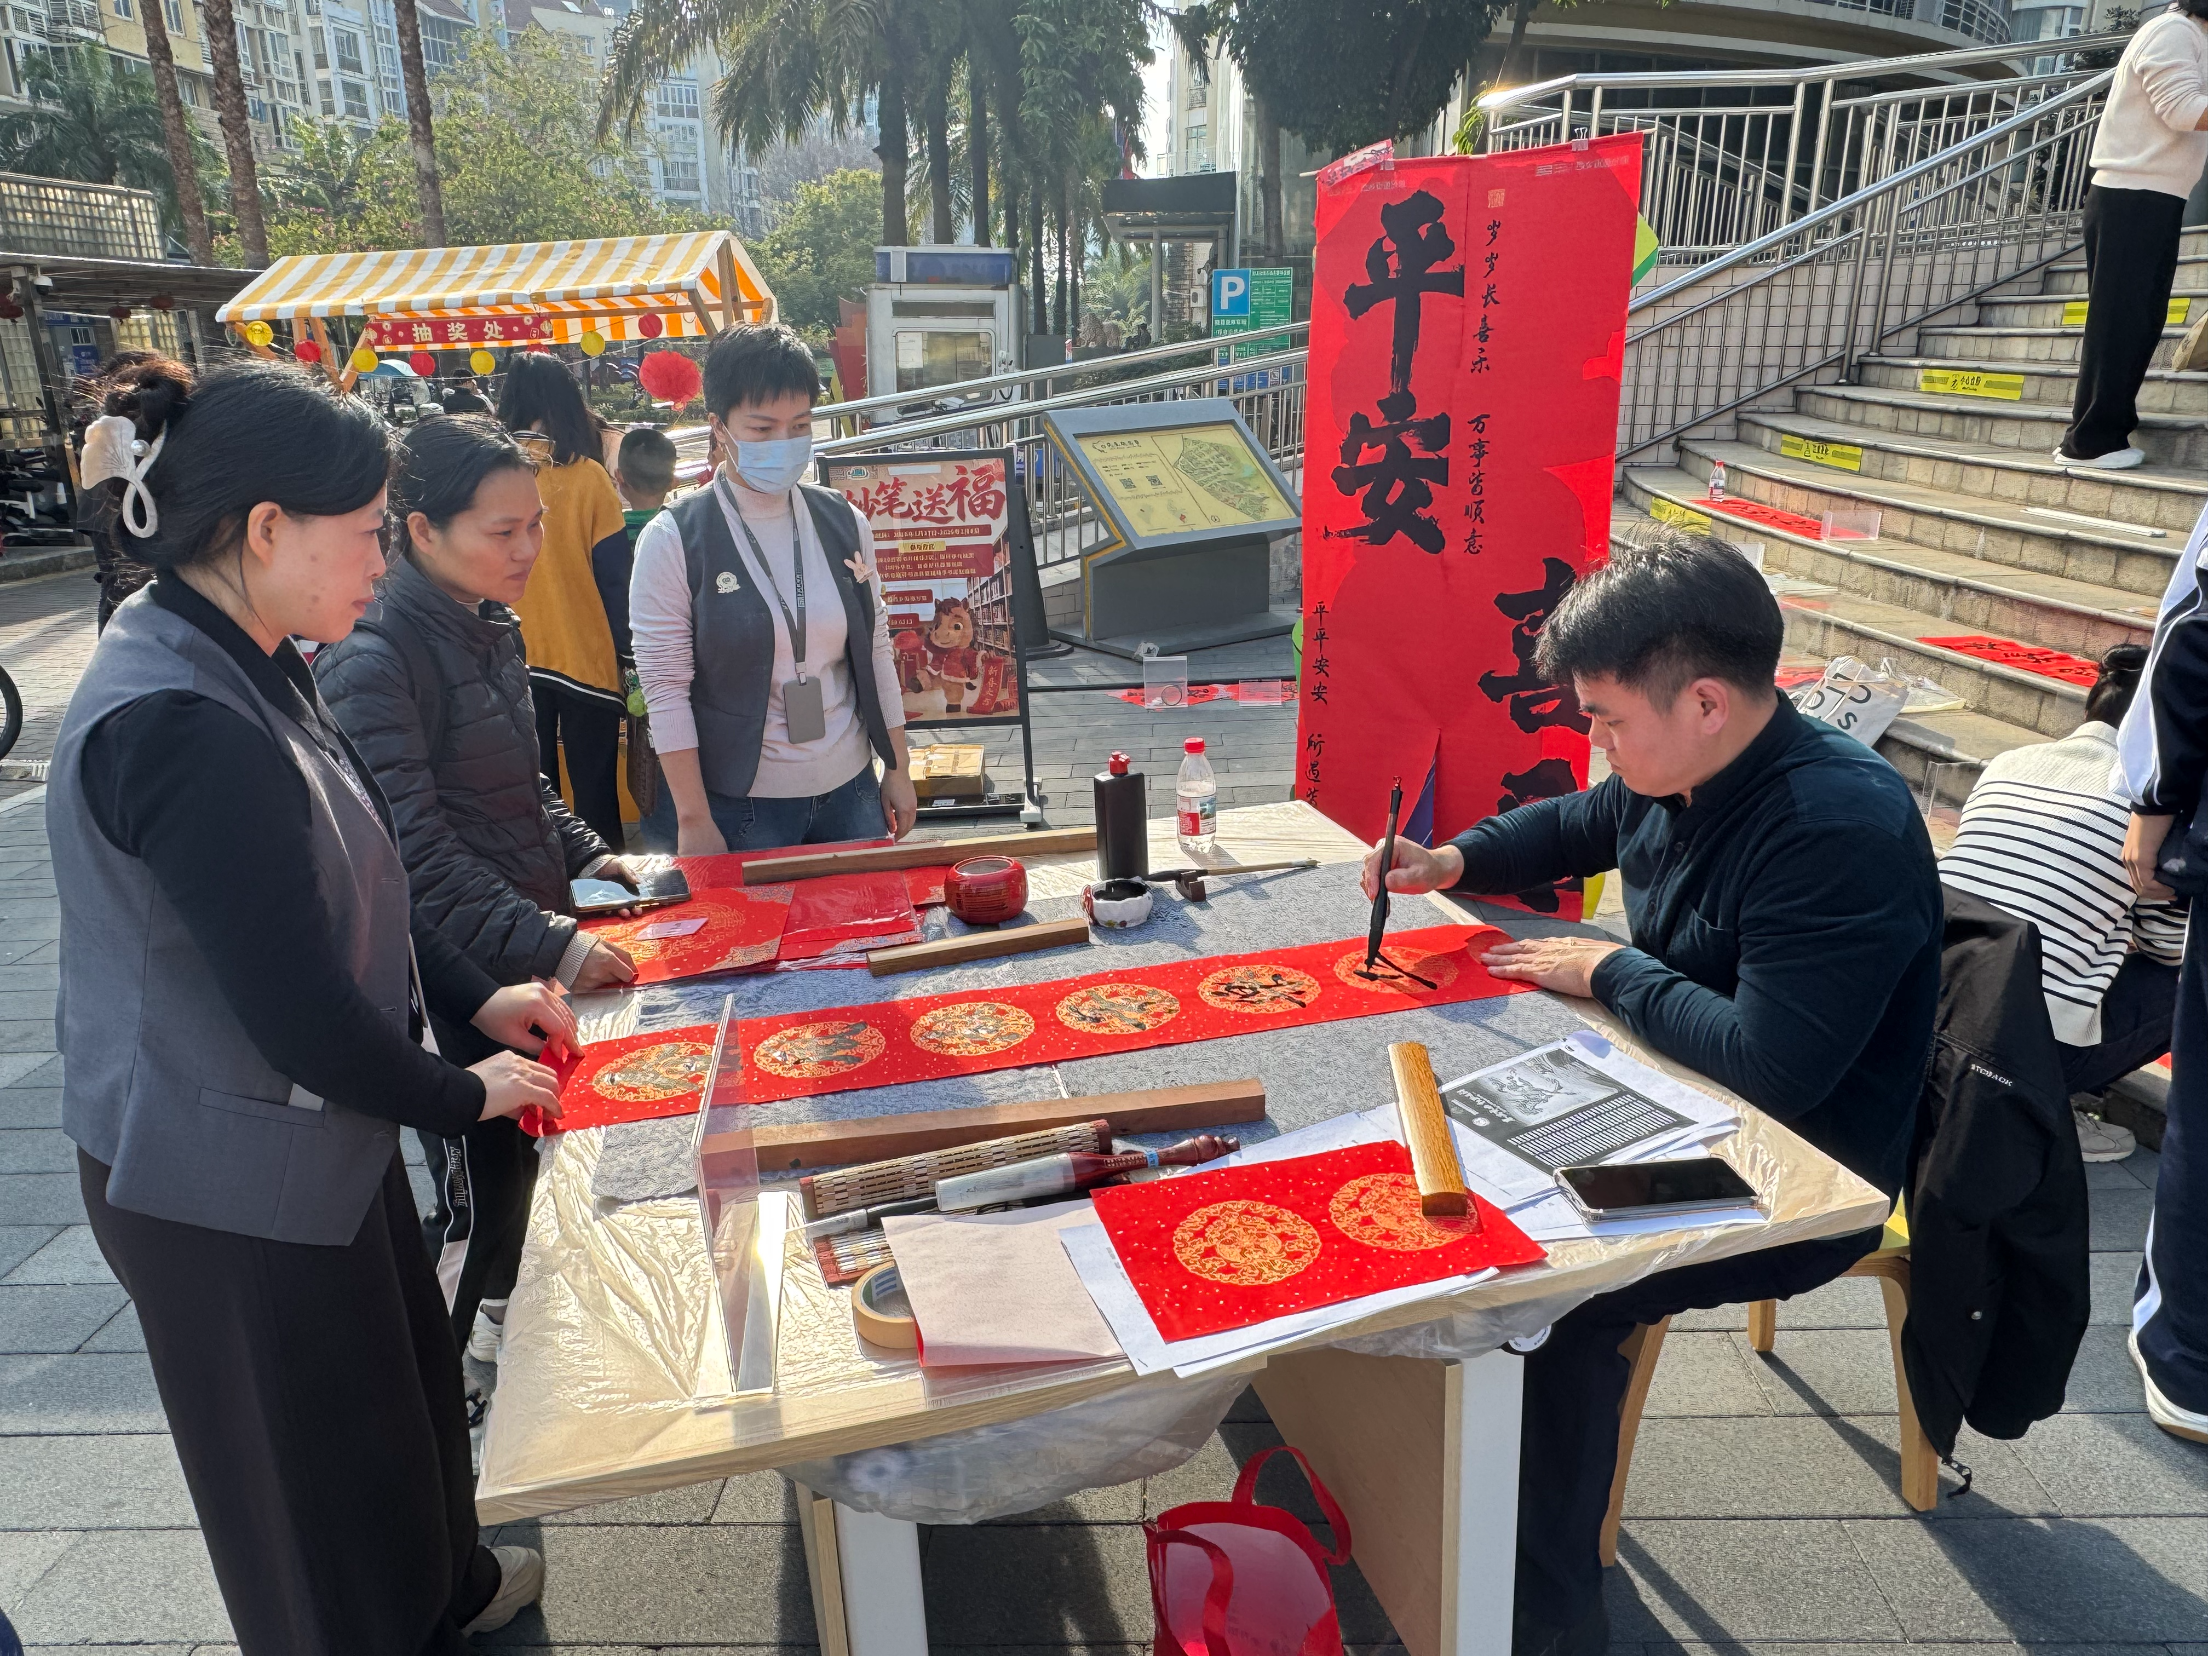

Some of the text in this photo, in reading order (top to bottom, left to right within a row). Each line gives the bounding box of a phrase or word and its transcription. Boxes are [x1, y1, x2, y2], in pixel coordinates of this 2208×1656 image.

[1220, 276, 1246, 310] P
[411, 320, 505, 343] 抽奖处
[1324, 190, 1465, 553] 平安
[1310, 600, 1331, 706] 平平安安
